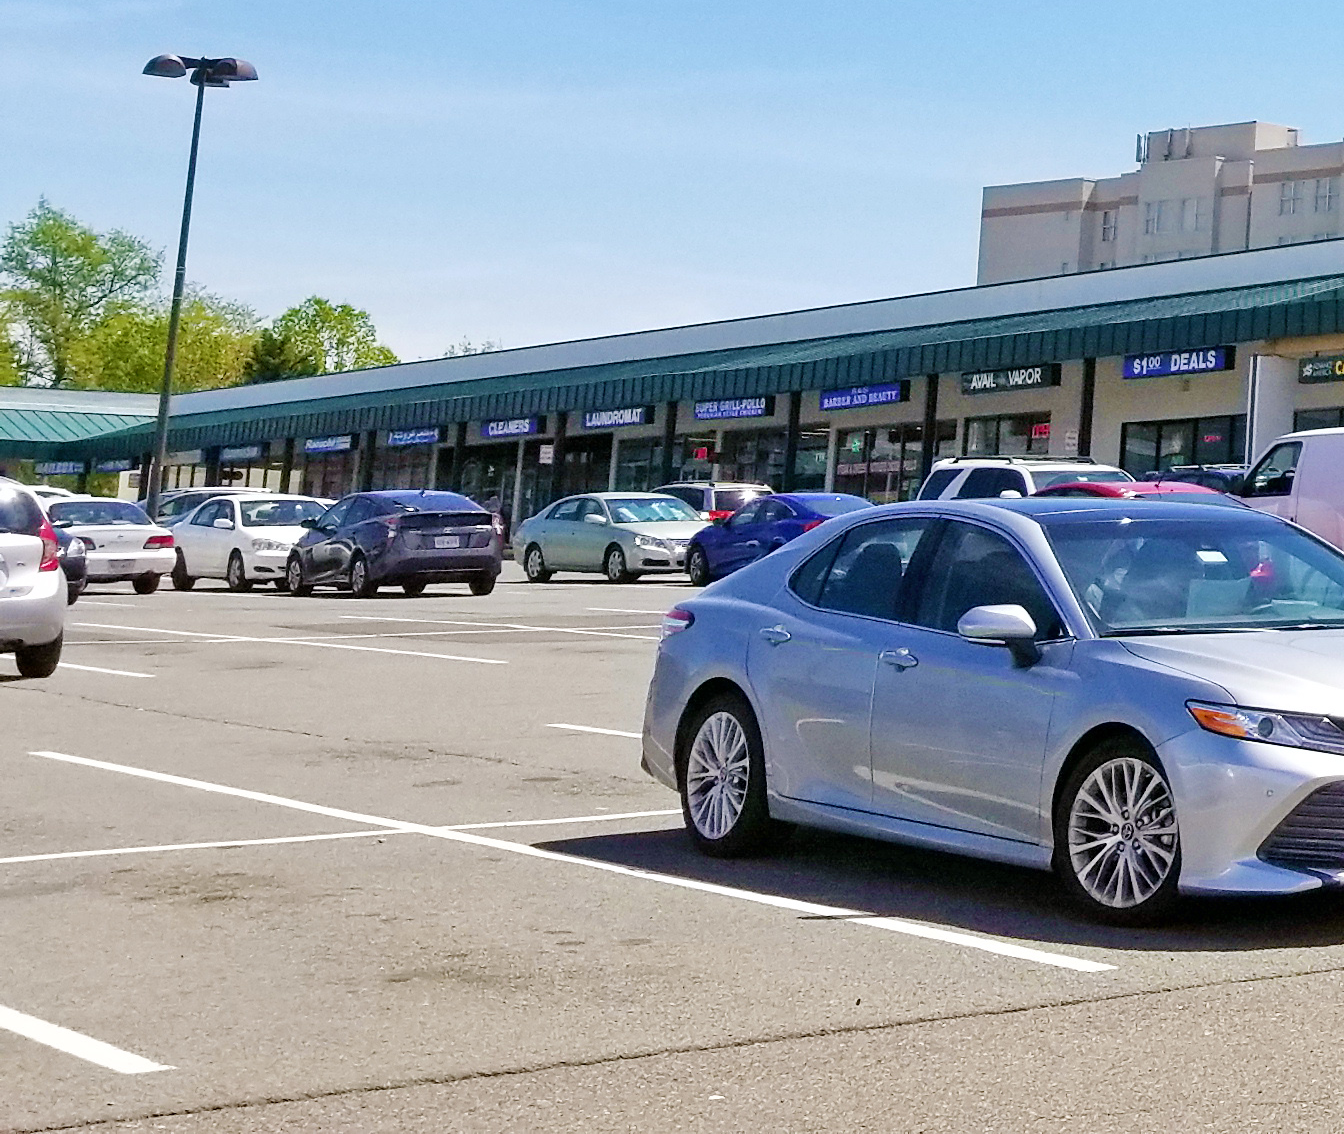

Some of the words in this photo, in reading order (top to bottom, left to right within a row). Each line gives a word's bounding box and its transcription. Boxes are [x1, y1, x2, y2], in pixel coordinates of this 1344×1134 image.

[1170, 350, 1216, 372] DEALS
[970, 373, 997, 389] AVAIL
[1008, 367, 1042, 386] VAPOR
[695, 401, 718, 413] SUPER
[823, 396, 851, 408] BARBER
[852, 393, 868, 405] AND
[869, 390, 898, 403] BEAUTY
[586, 408, 643, 427] LAUNDROMAT
[488, 419, 530, 436] CLEANERS
